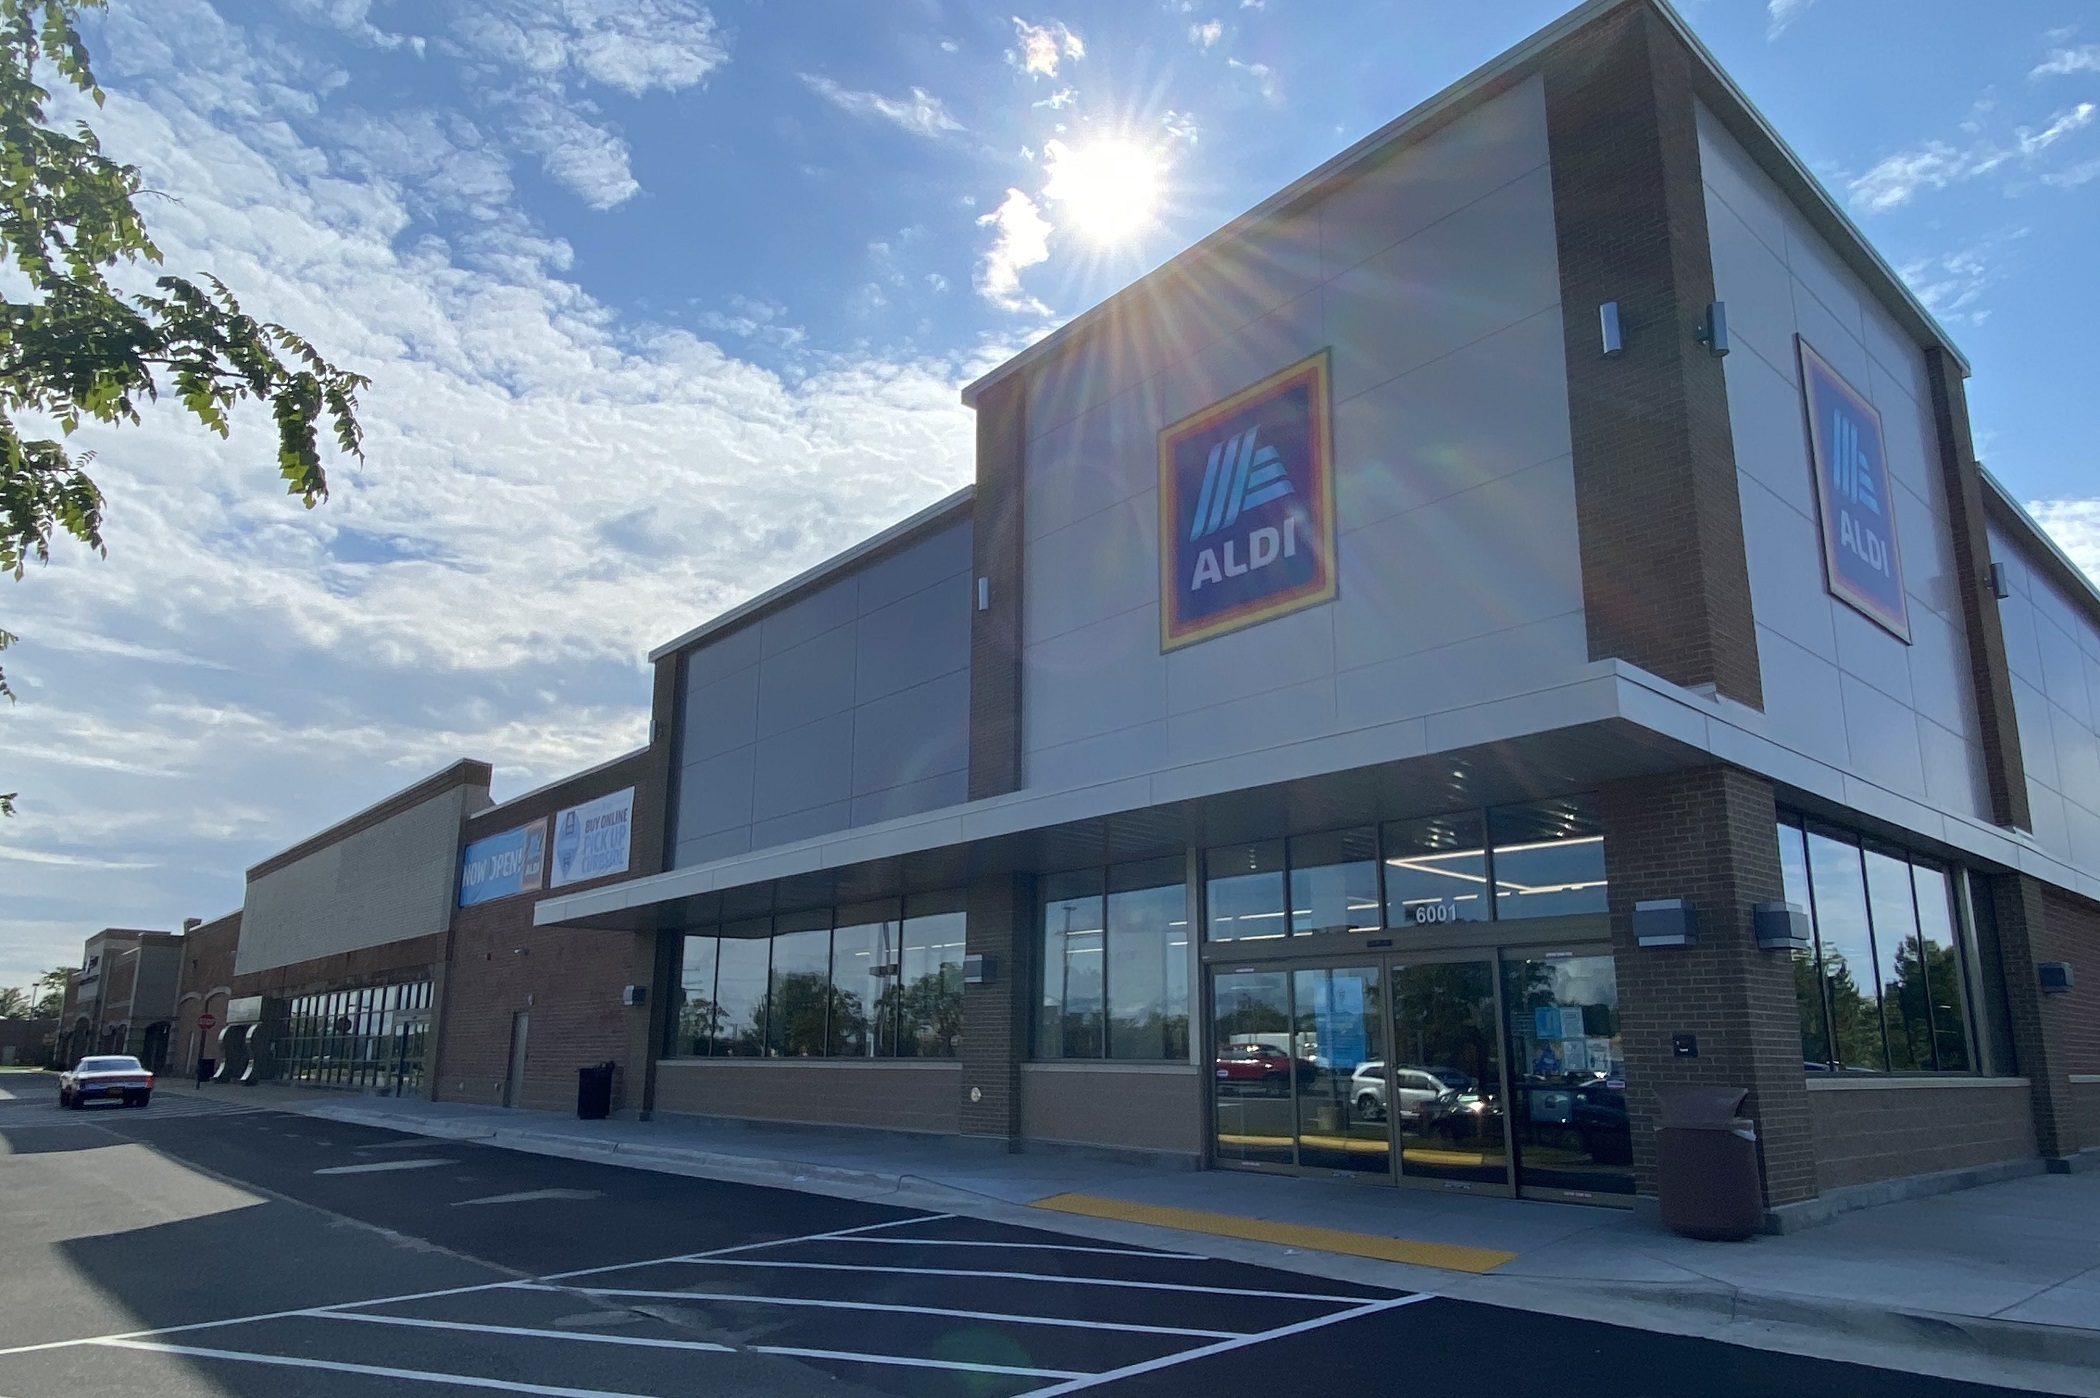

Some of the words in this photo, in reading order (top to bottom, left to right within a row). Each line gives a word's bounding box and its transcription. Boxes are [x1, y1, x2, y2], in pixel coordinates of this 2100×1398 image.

[1191, 516, 1297, 591] ALDI
[1841, 509, 1890, 579] ALDI
[585, 816, 600, 833] BUY
[601, 808, 628, 829] ONLINE
[584, 829, 609, 855] PICK
[611, 825, 627, 848] UP
[462, 858, 488, 888] NOW
[525, 861, 541, 876] ALDI
[1416, 904, 1456, 923] 6001
